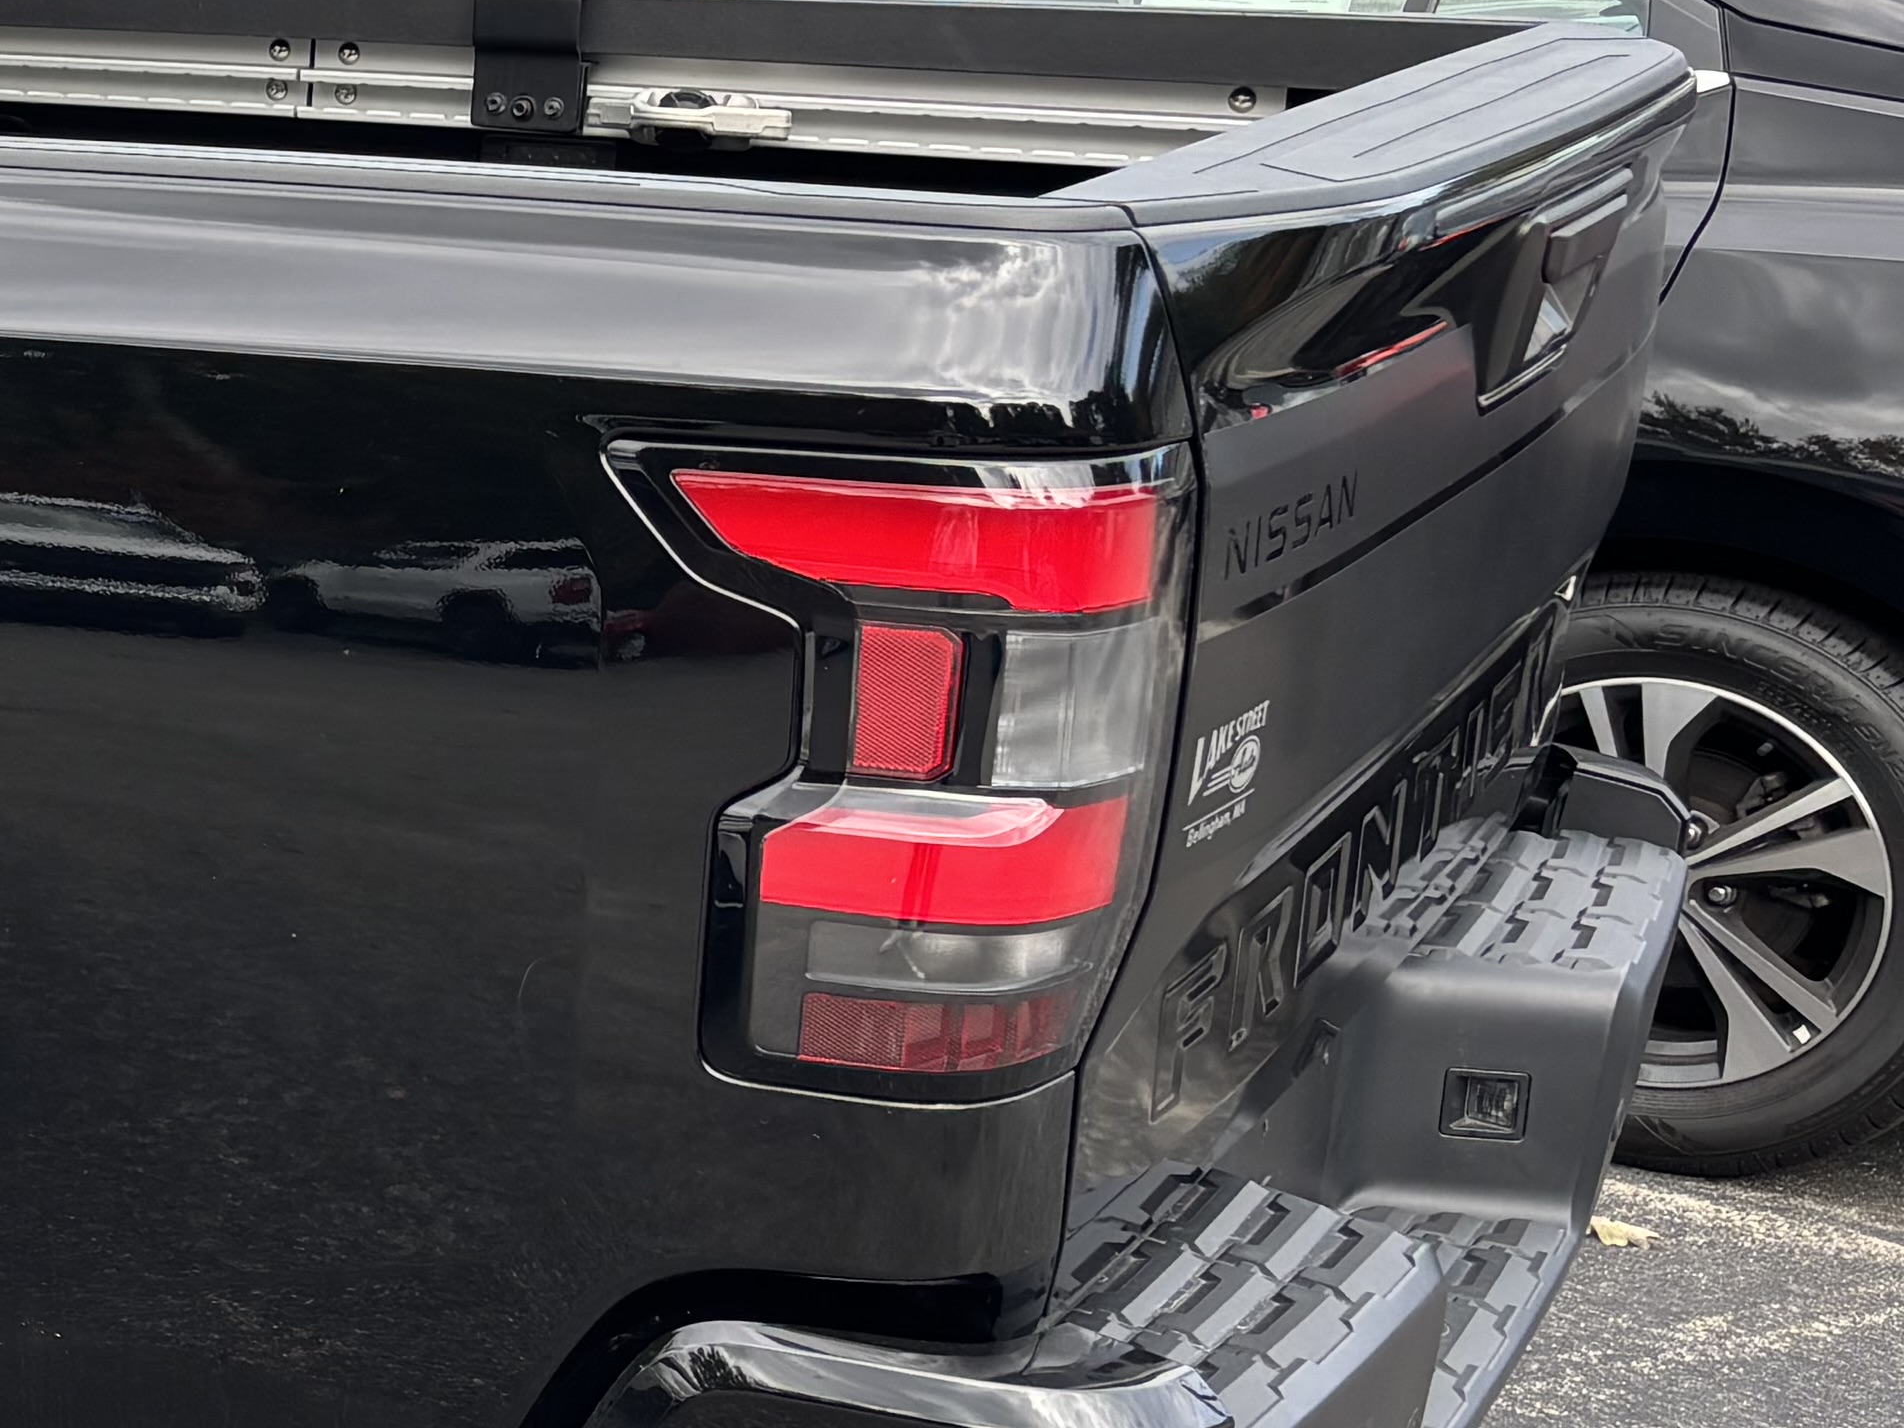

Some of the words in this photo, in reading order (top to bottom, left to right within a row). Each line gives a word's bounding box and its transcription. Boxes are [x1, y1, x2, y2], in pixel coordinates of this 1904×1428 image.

[1224, 468, 1358, 581] NISSAN
[1187, 719, 1236, 807] LAKE
[1234, 699, 1270, 742] STREET
